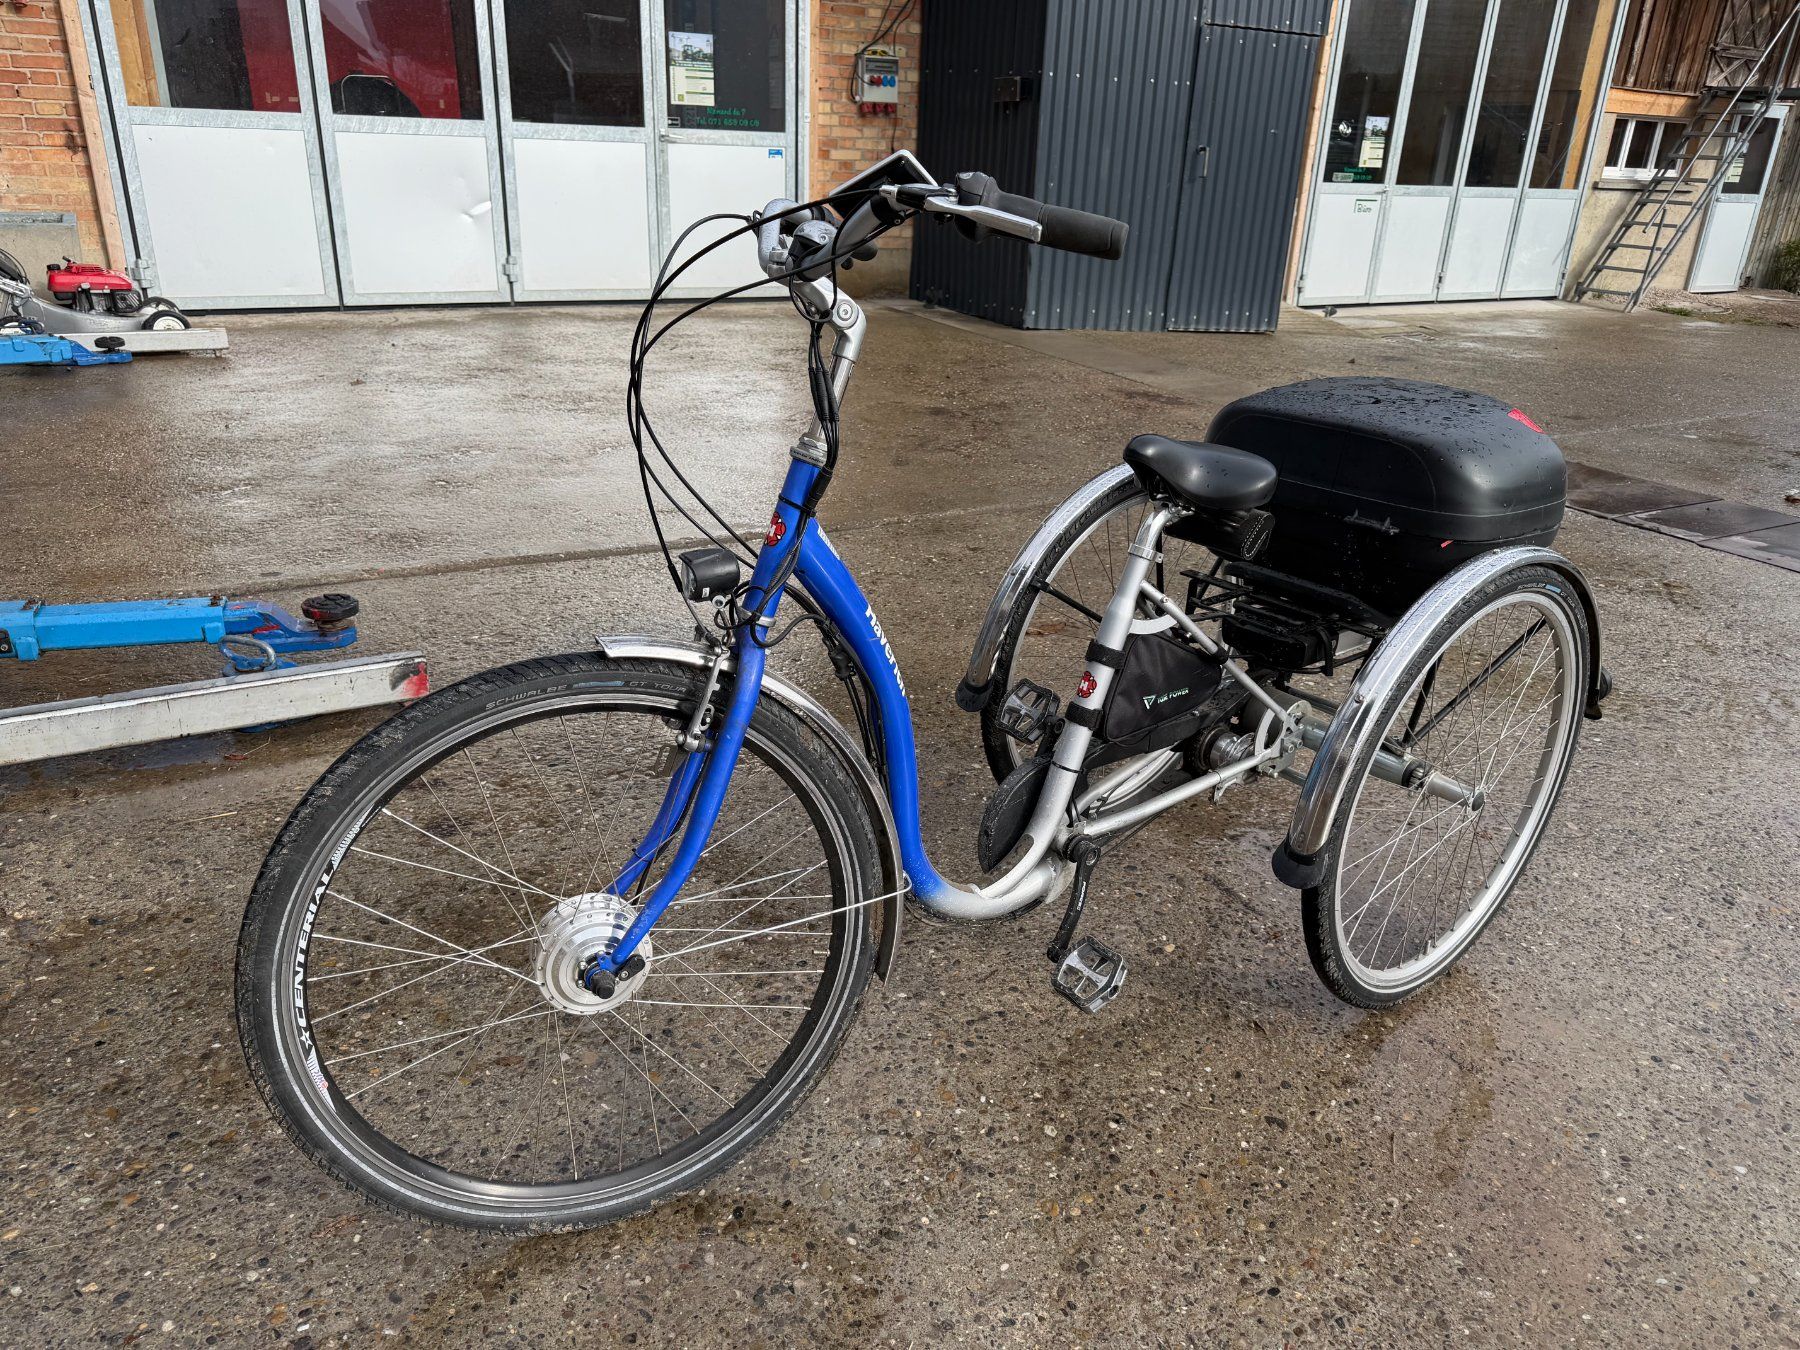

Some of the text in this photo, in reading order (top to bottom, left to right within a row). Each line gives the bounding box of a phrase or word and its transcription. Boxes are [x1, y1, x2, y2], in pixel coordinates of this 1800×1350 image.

[485, 684, 568, 711] SCHWALBE
[654, 682, 688, 693] TOUR
[294, 868, 335, 1028] CENTERIAL
